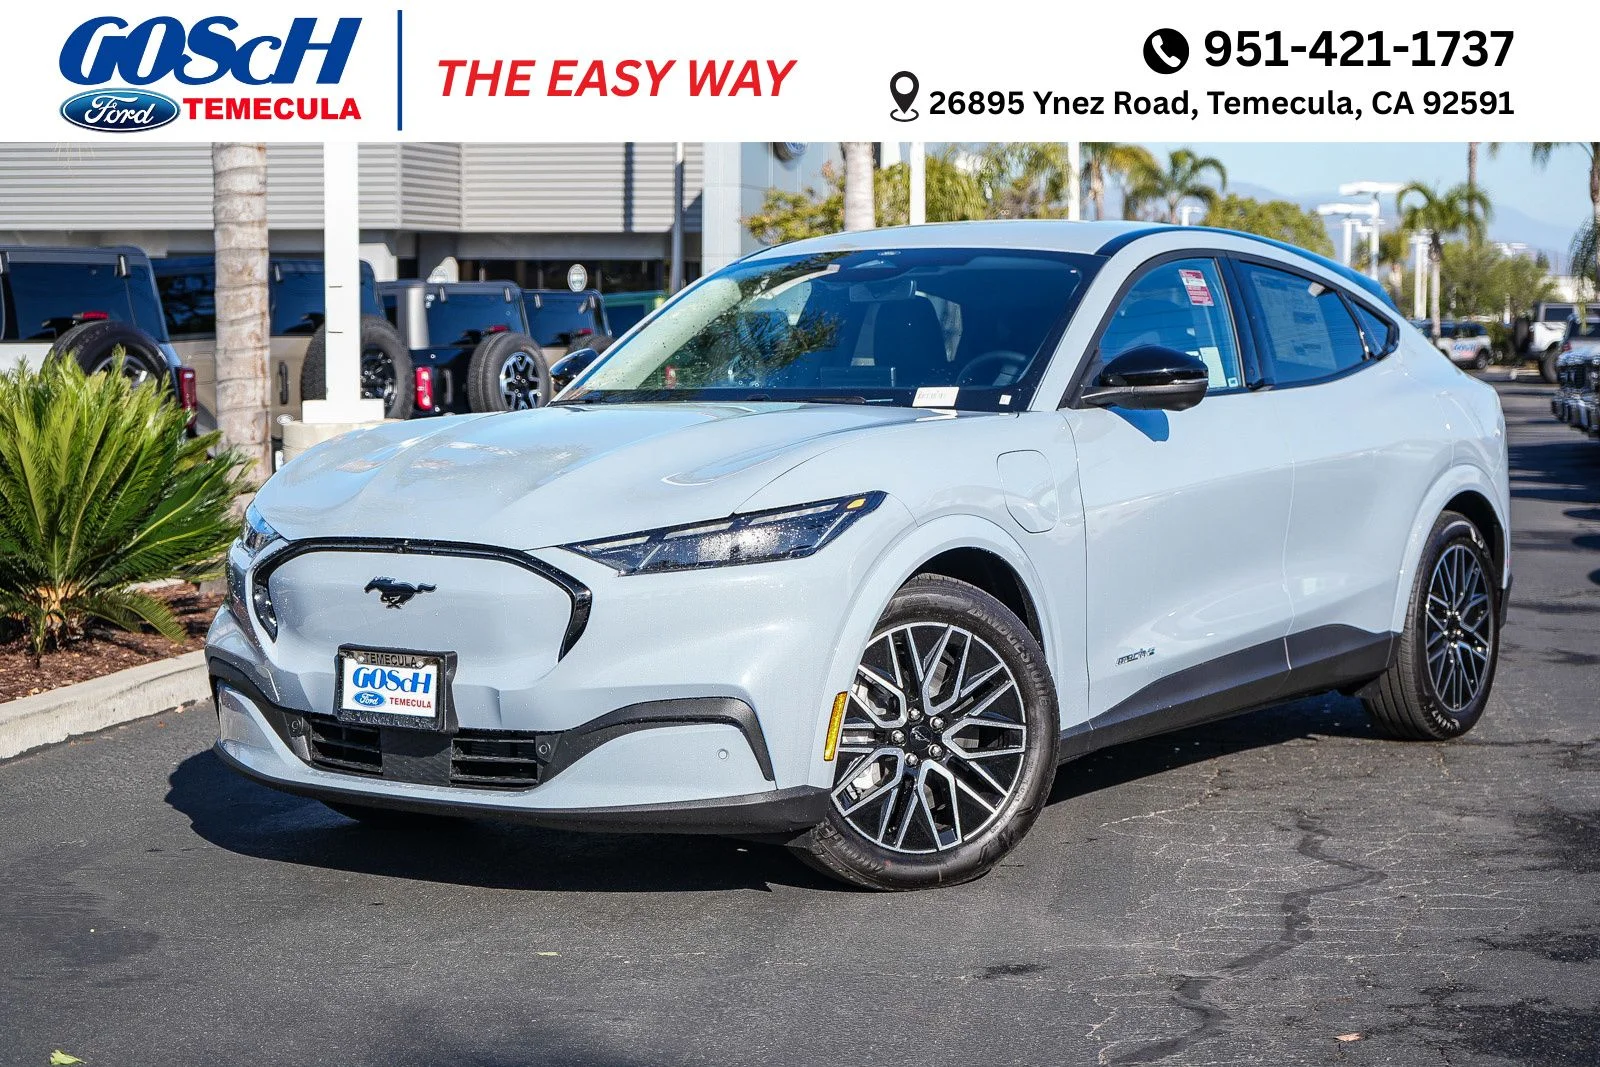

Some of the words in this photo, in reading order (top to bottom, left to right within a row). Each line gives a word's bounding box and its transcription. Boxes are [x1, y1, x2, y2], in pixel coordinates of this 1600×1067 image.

[363, 653, 417, 667] TEMECULA
[358, 693, 378, 704] Ford
[390, 698, 431, 708] TEMECULA
